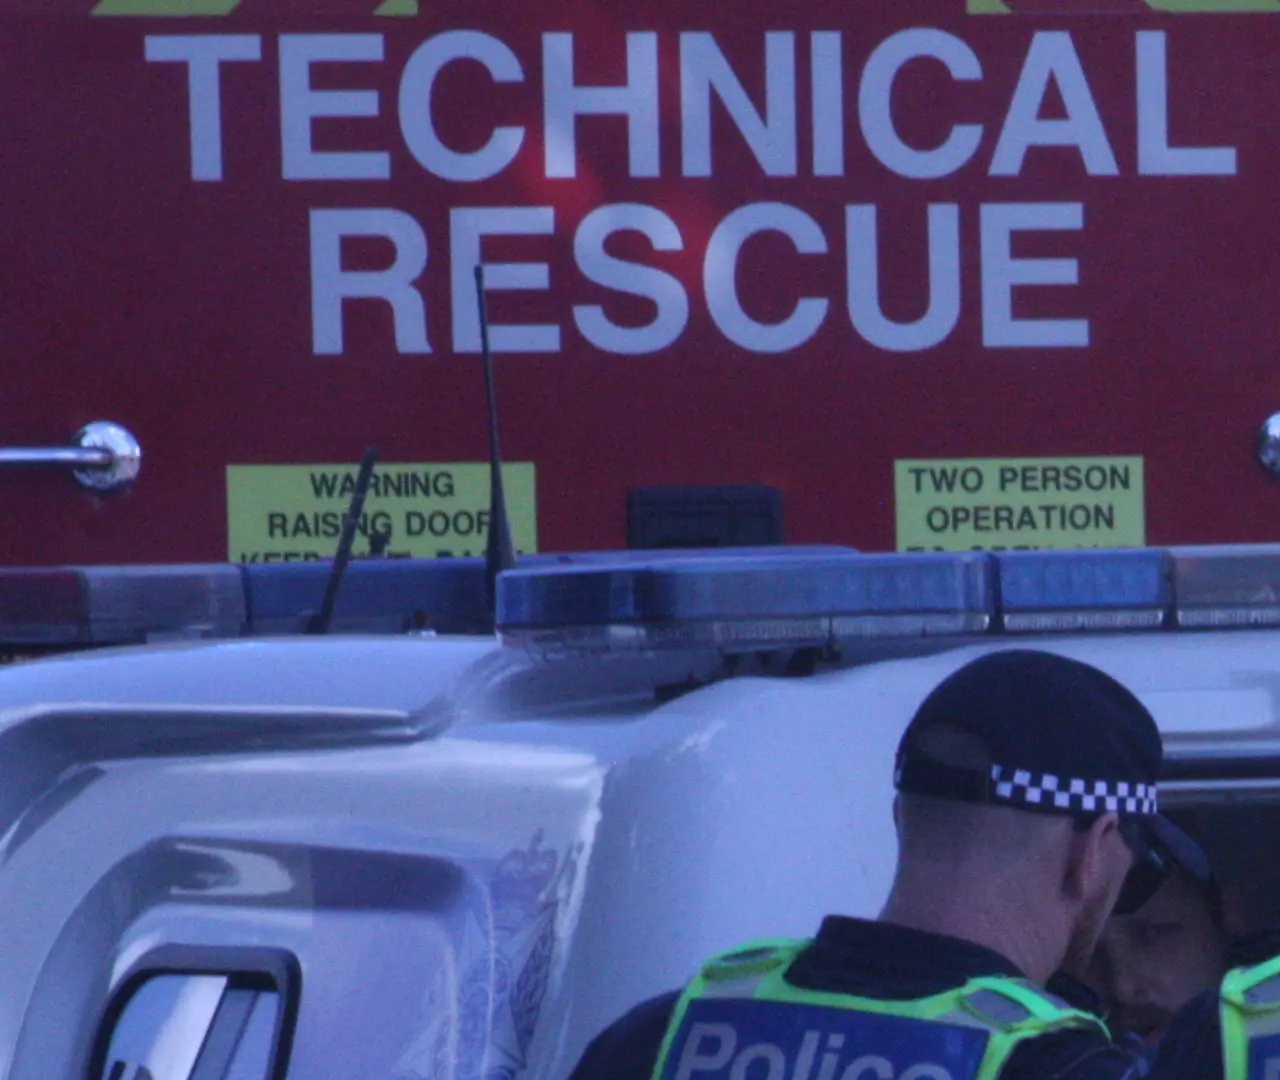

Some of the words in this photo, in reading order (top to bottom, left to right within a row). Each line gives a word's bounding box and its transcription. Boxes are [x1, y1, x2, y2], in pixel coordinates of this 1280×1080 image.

[144, 28, 1238, 182] TECHNICAL
[309, 201, 1090, 355] RESCUE
[309, 471, 455, 498] WARNING
[908, 466, 984, 494] TWO
[999, 464, 1130, 493] PERSON
[267, 510, 392, 538] RAISING
[926, 503, 1115, 533] OPERATION
